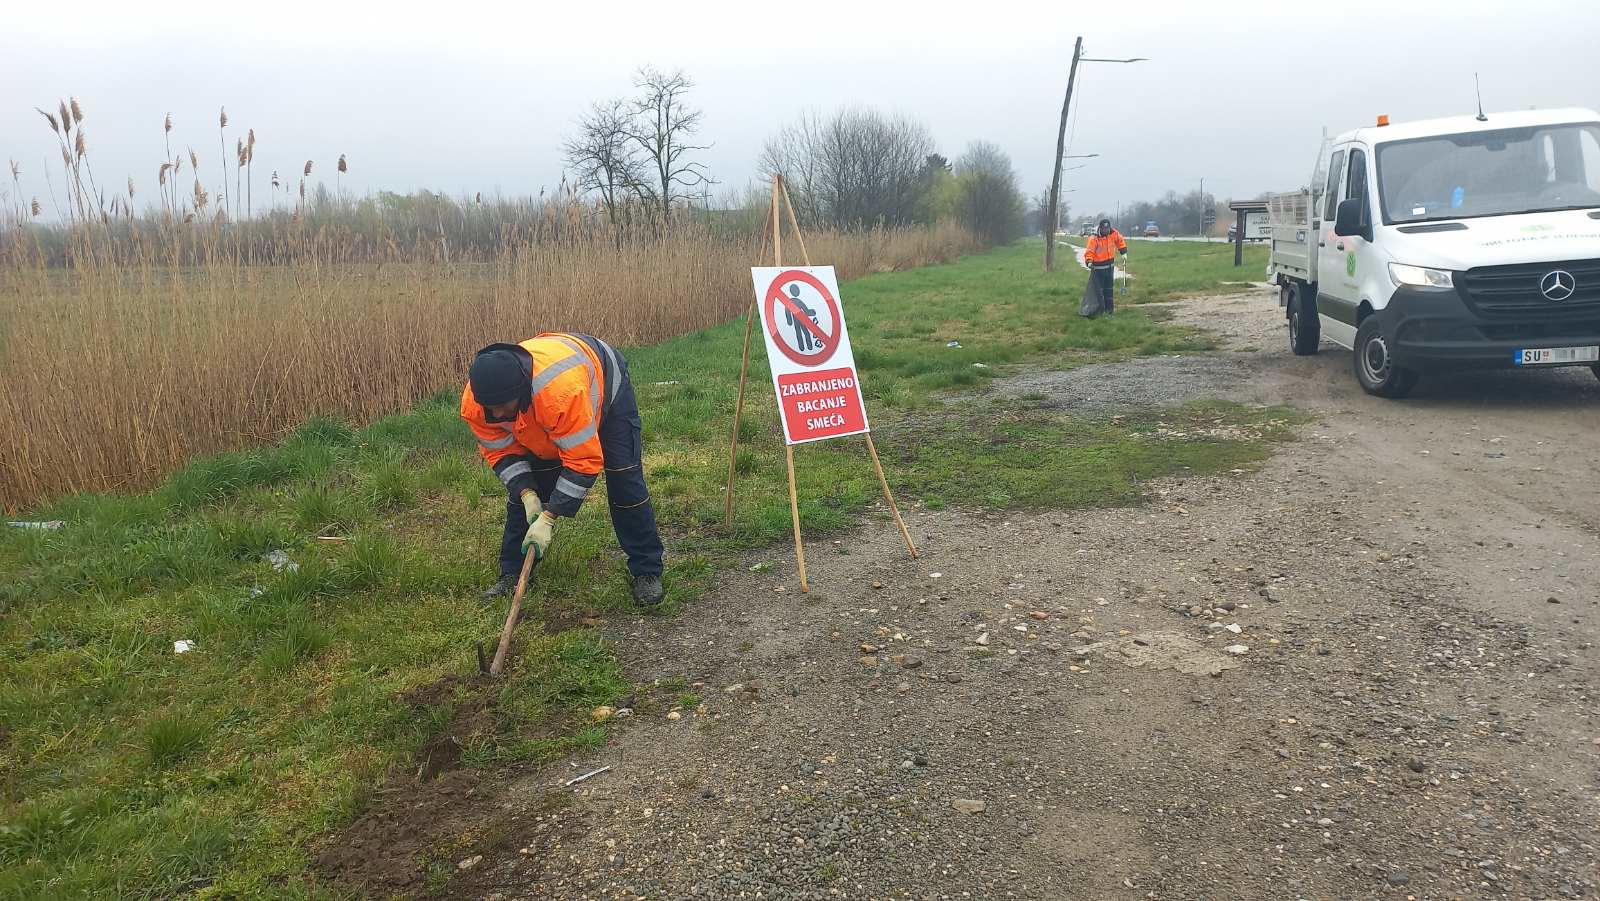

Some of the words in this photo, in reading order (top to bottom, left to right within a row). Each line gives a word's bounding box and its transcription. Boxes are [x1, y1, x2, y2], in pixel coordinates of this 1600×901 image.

[1524, 350, 1541, 362] SU
[781, 377, 853, 396] ZABRANJENO
[797, 396, 846, 412] BACANJE
[807, 413, 845, 430] SMEĆA
